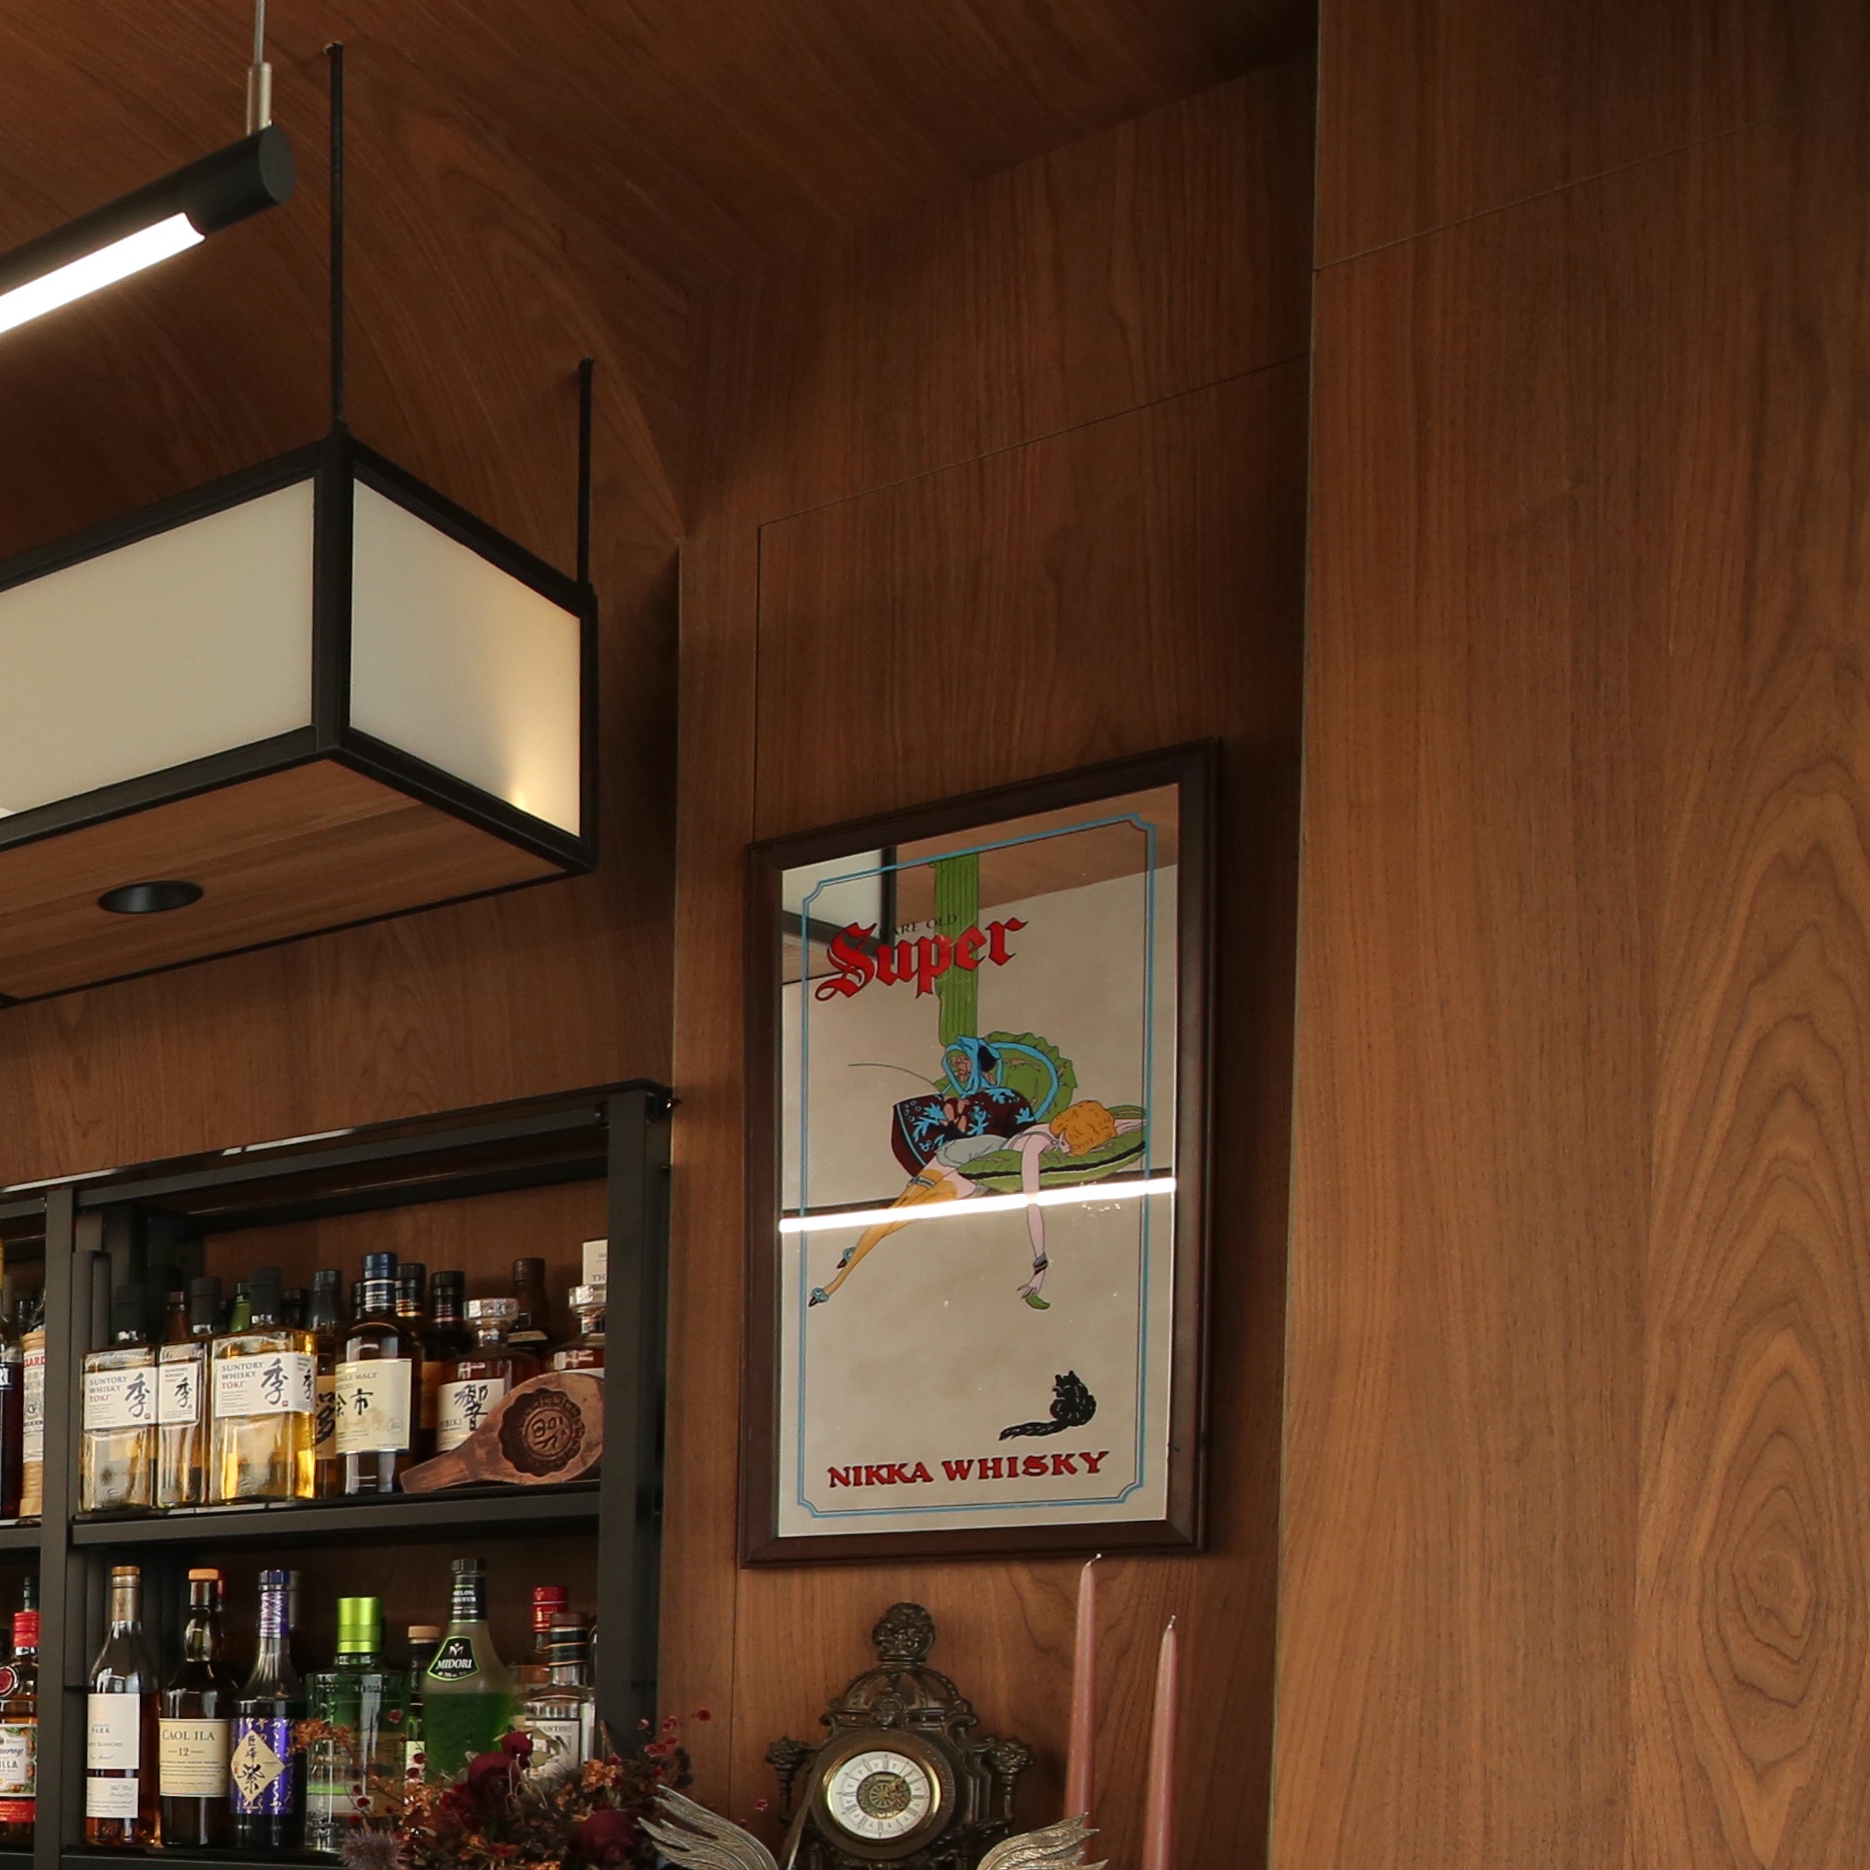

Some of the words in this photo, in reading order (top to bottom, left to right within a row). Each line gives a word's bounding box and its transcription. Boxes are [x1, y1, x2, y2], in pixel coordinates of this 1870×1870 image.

[926, 914, 958, 929] OLD
[814, 916, 1029, 1002] Super
[221, 1360, 265, 1373] SUNTORY
[89, 1375, 128, 1387] SUNTORY
[221, 1370, 258, 1381] WHISKY
[261, 1357, 289, 1406] 季
[89, 1385, 121, 1395] WHISKY
[125, 1372, 151, 1418] 季
[827, 1462, 934, 1488] NIKKA
[941, 1450, 1110, 1481] WHISKY
[435, 1658, 473, 1670] MIDORI
[162, 1728, 191, 1741] CAOL
[194, 1730, 216, 1741] ILA
[177, 1746, 190, 1757] 12
